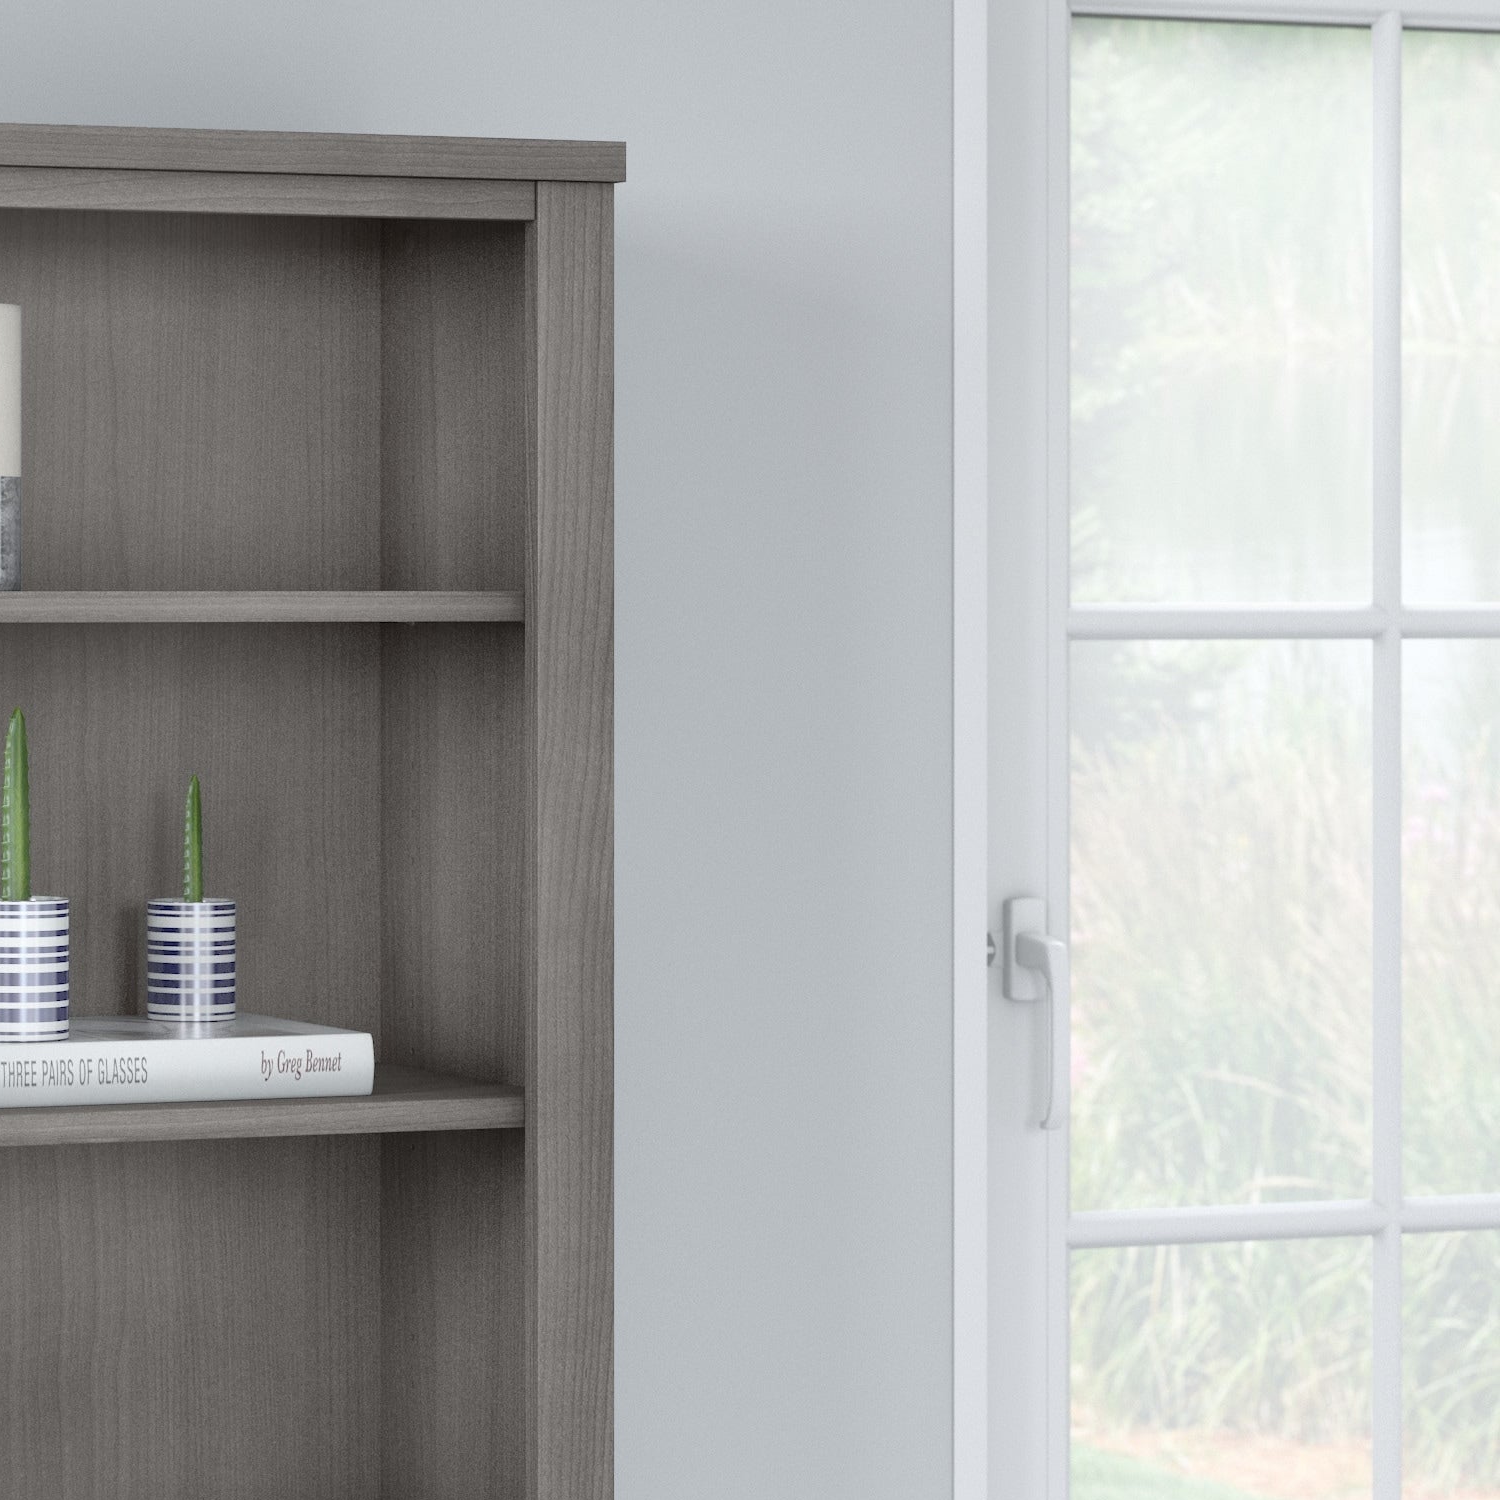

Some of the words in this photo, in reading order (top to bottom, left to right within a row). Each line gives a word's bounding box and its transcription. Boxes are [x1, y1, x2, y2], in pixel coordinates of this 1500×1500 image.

[1, 1060, 37, 1088] THREE
[42, 1059, 74, 1087] PAIRS
[79, 1058, 93, 1086] OF
[98, 1056, 148, 1086] GLASSES
[261, 1050, 274, 1082] by
[277, 1049, 302, 1081] Greg
[305, 1048, 342, 1073] Bennet
